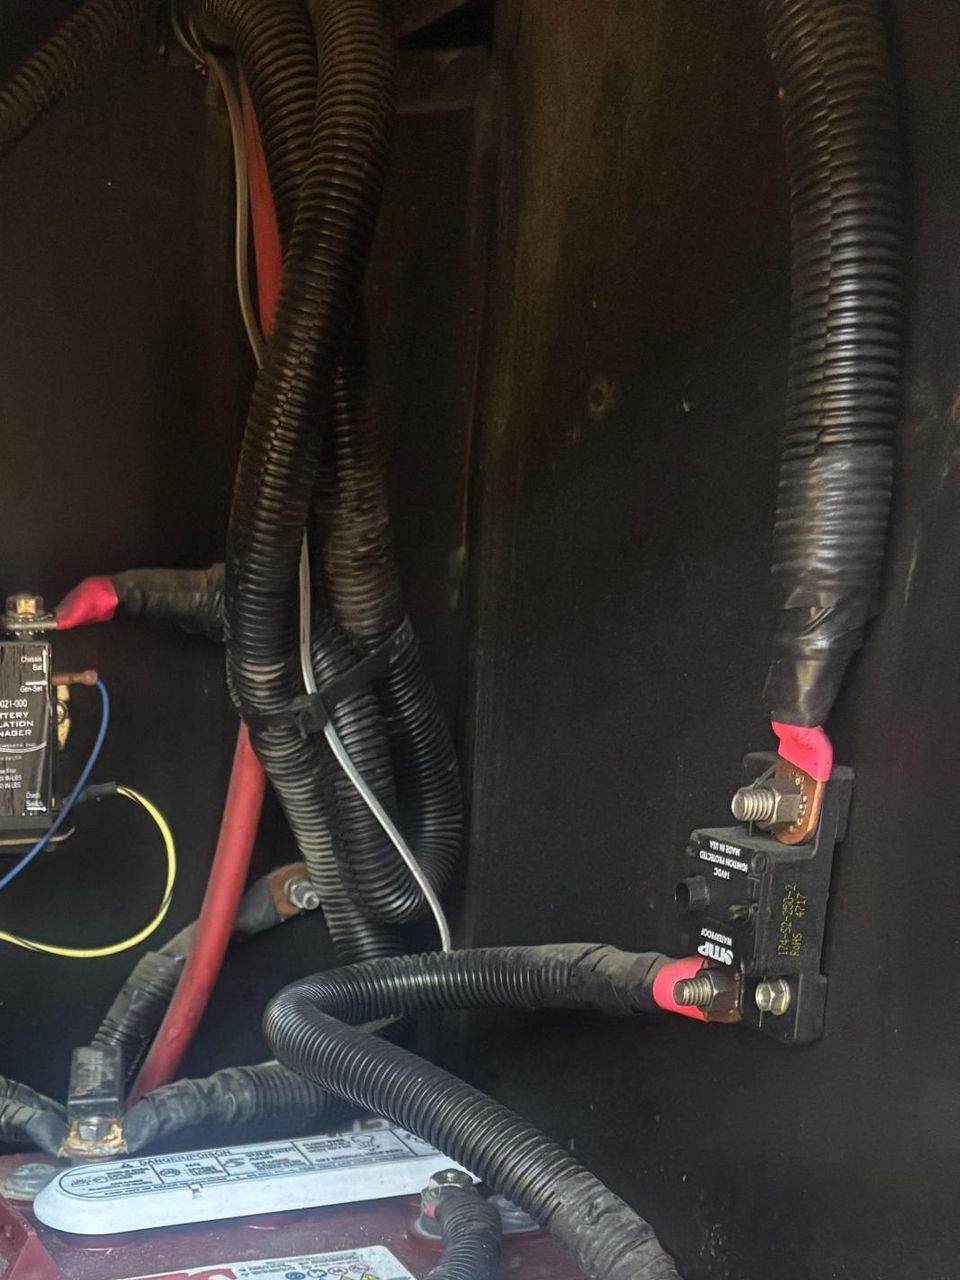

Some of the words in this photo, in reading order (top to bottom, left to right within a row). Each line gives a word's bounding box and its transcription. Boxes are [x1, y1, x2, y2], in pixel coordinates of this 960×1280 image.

[699, 850, 725, 866] PROTECTED
[725, 857, 748, 873] IGNITION
[700, 927, 733, 947] WATERPROOF
[140, 1149, 232, 1166] DANGER/POISON
